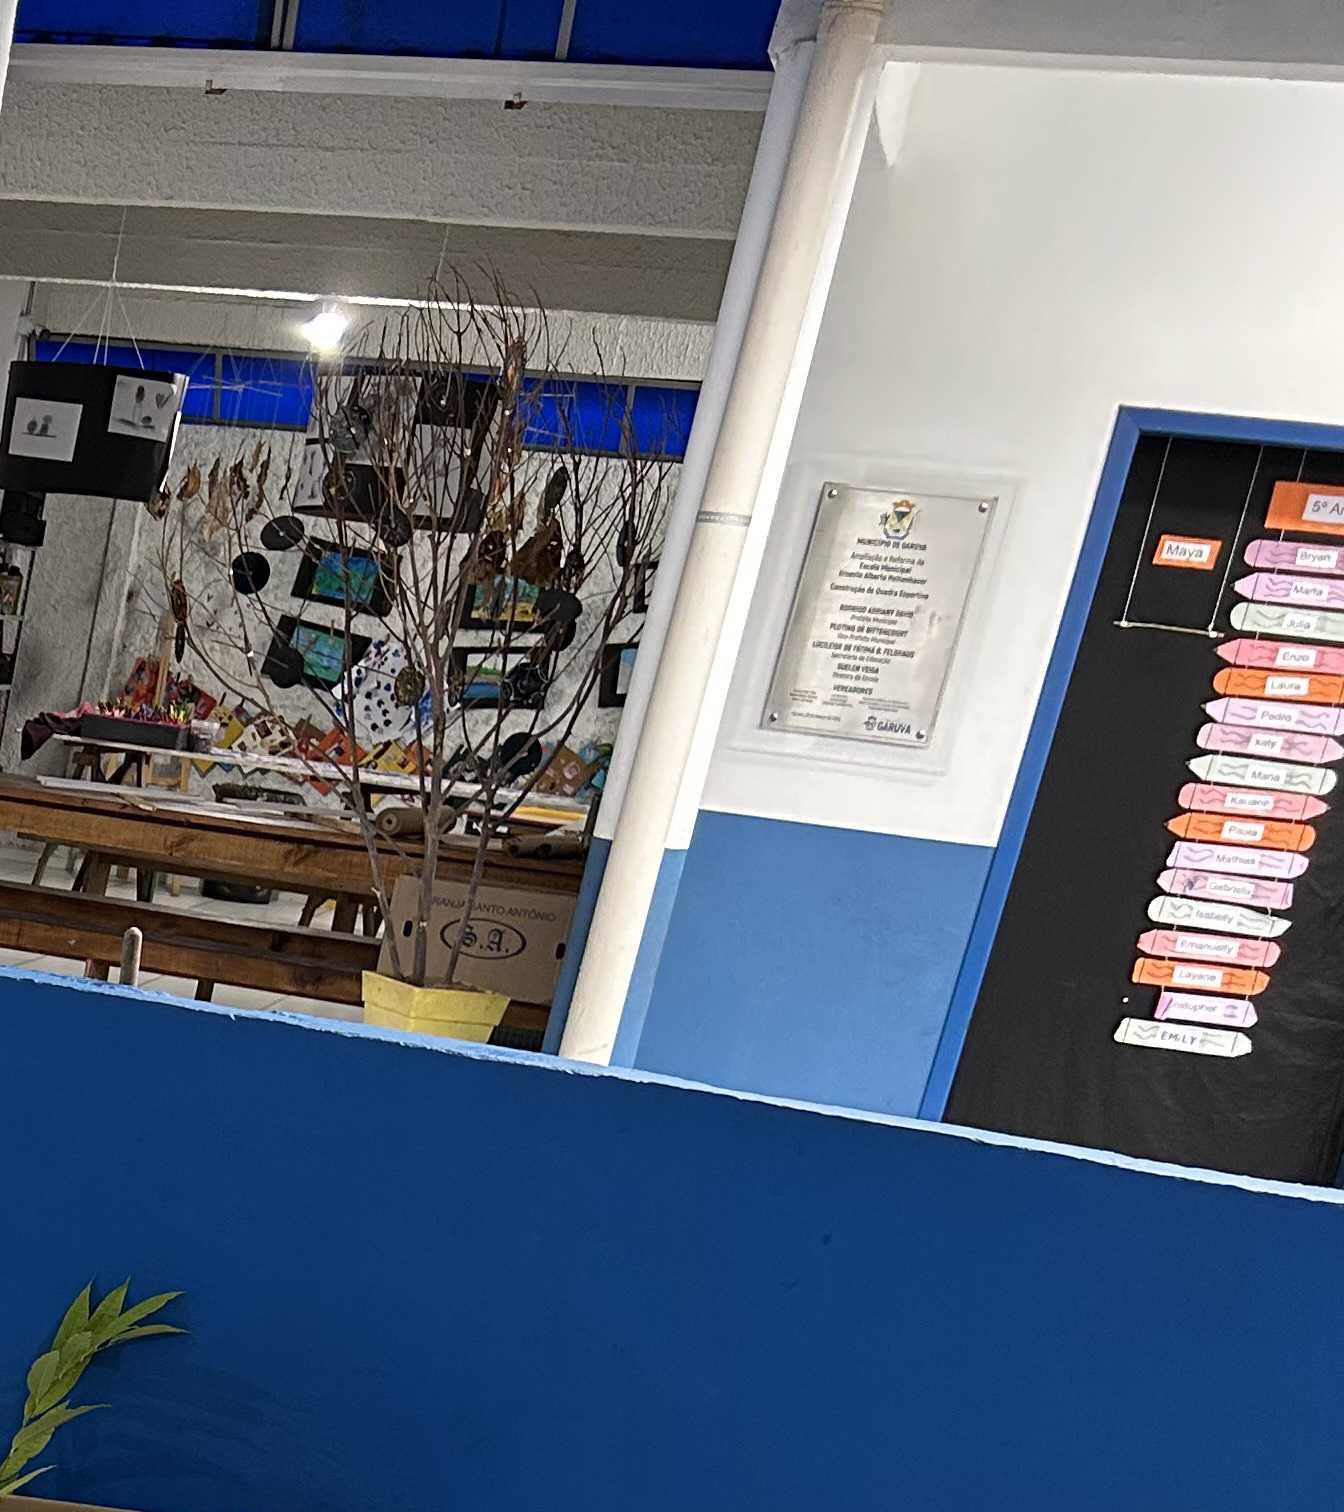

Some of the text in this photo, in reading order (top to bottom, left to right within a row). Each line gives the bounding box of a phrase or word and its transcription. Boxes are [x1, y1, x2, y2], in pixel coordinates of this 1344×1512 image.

[1166, 543, 1203, 559] Maya
[1282, 651, 1310, 662] Enzo
[877, 720, 911, 735] GARUVA
